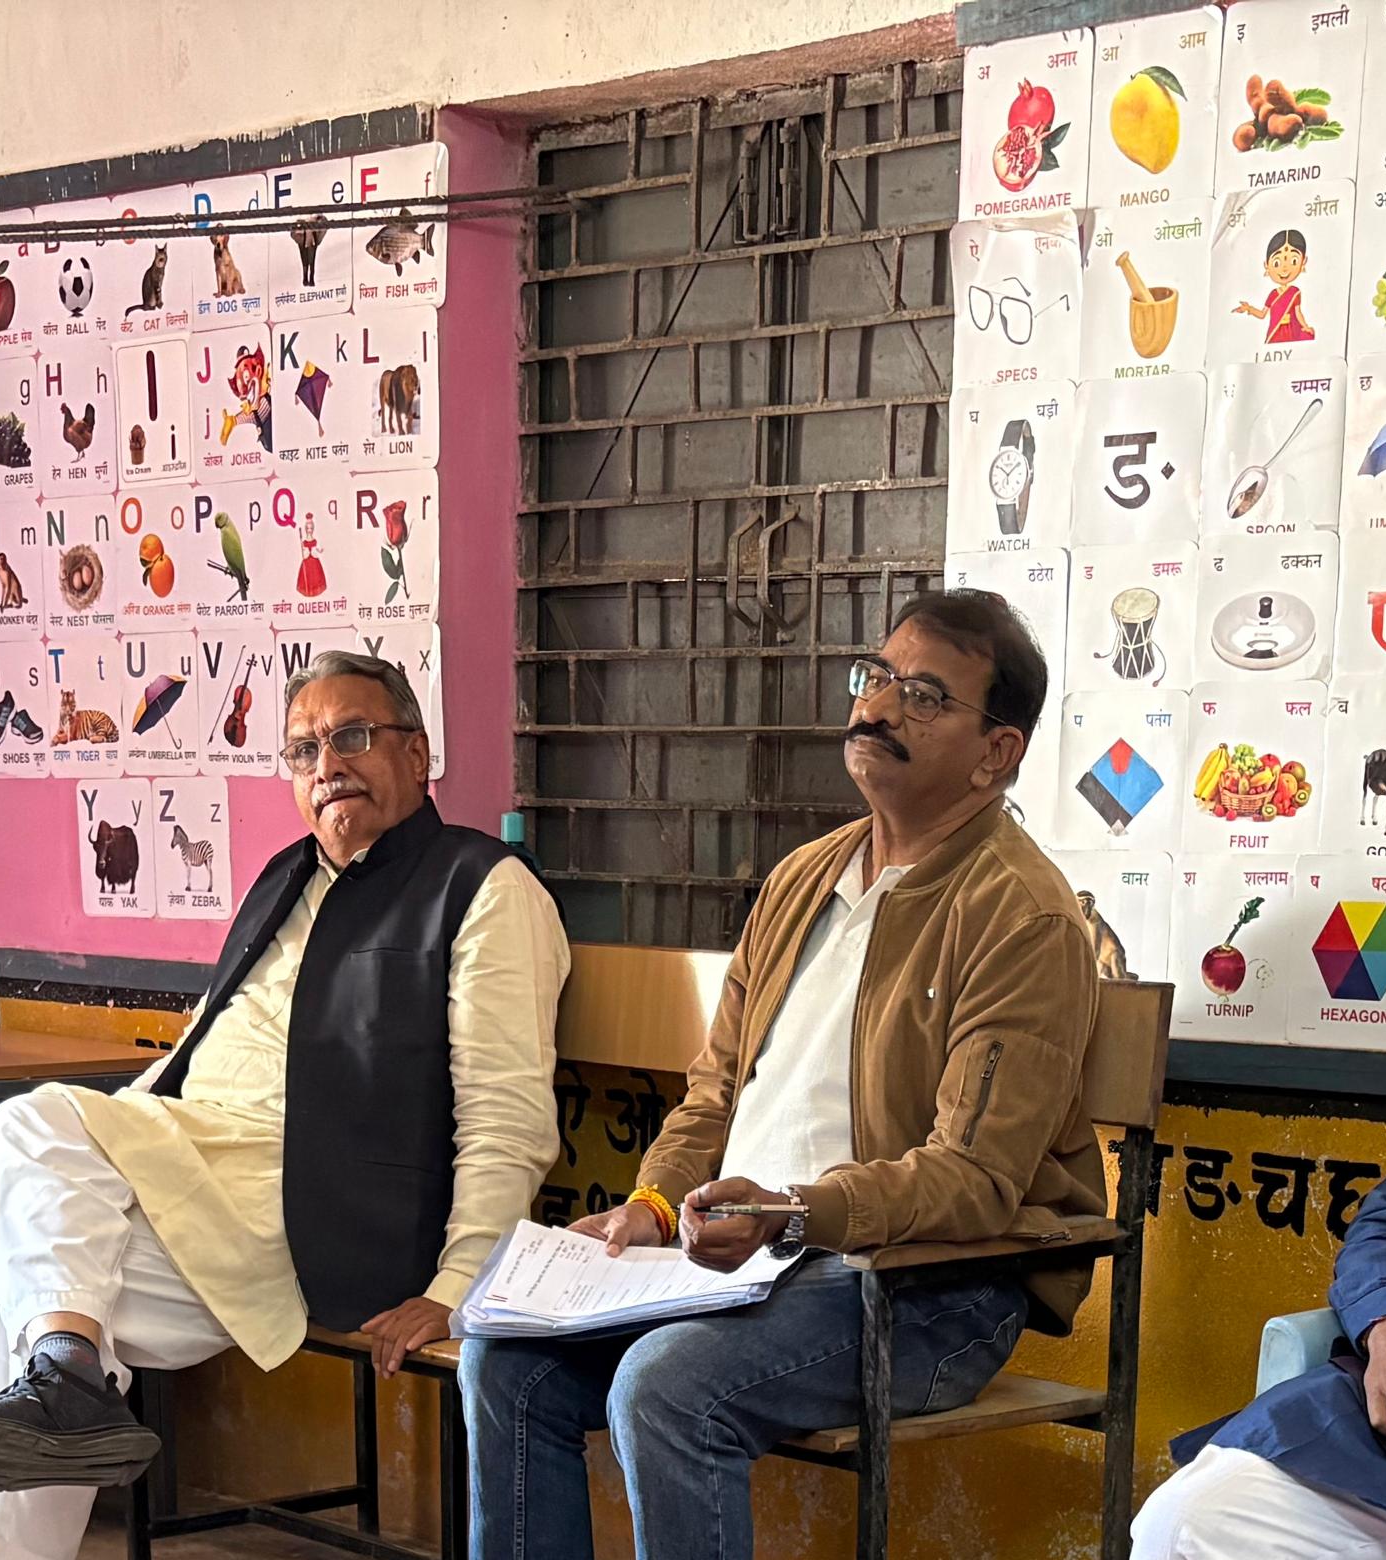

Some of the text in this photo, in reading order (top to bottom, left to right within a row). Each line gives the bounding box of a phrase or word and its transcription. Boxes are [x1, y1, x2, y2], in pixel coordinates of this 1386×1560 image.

[1236, 9, 1349, 43] इ इमली
[1102, 31, 1206, 62] आ आम
[978, 51, 1077, 80] अ अनार
[1248, 165, 1321, 187] TAMARIND
[332, 181, 344, 203] e
[361, 167, 378, 204] F
[974, 191, 1072, 216] POMEGRANATE
[1120, 188, 1170, 207] MANGO
[1305, 195, 1339, 216] औरत
[1154, 217, 1201, 241] ओखली
[300, 289, 333, 303] ELEPHANT
[386, 285, 408, 298] FISH
[217, 300, 237, 312] DOG
[66, 322, 89, 335] BALL
[144, 318, 160, 331] CAT
[280, 332, 347, 371] K k
[363, 328, 379, 364] L
[197, 347, 211, 383] J
[1115, 365, 1170, 379] MORTAR
[46, 363, 107, 396] H h
[997, 368, 1037, 383] SPECS
[1360, 376, 1372, 390] छ
[20, 379, 30, 405] g
[1291, 378, 1331, 394] चम्मच
[970, 399, 1058, 423] घ घड़ी
[205, 409, 210, 440] j
[171, 425, 176, 460] i
[389, 441, 412, 454] LION
[231, 452, 261, 466] JOKER
[306, 446, 327, 459] KITE
[4, 472, 33, 487] GRAPES
[68, 467, 87, 480] HEN
[121, 497, 184, 534] O o
[195, 496, 261, 533] P p
[273, 488, 296, 529] Q
[356, 490, 430, 529] R r
[21, 527, 36, 545] m
[46, 510, 109, 546] N n
[987, 539, 1030, 552] WATCH
[1028, 562, 1053, 581] ठठेरा
[1085, 562, 1182, 580] ड डमरू
[1214, 553, 1322, 572] ढ ढक्कन
[143, 604, 174, 616] ORANGE
[215, 604, 248, 616] PARROT
[298, 601, 330, 614] QUEEN
[377, 606, 405, 618] ROSE
[67, 616, 89, 627] NEST
[48, 649, 105, 683] T t
[127, 642, 191, 677] U u
[203, 642, 222, 679] V
[29, 667, 38, 687] s
[1203, 702, 1311, 716] फ फल
[1074, 709, 1171, 728] प पतंग
[3, 753, 30, 764] SHOES
[77, 751, 99, 761] TIGER
[148, 752, 183, 760] UMBRELLA
[232, 754, 254, 764] VIOLIN
[81, 790, 141, 826] Y y
[160, 790, 221, 822] Z z
[1230, 835, 1269, 848] FRUIT
[1121, 872, 1149, 886] वानर
[1184, 872, 1288, 886] श शलगम
[121, 898, 137, 908] YAK
[192, 896, 221, 907] ZEBRA
[1206, 1004, 1254, 1017] TURNIP
